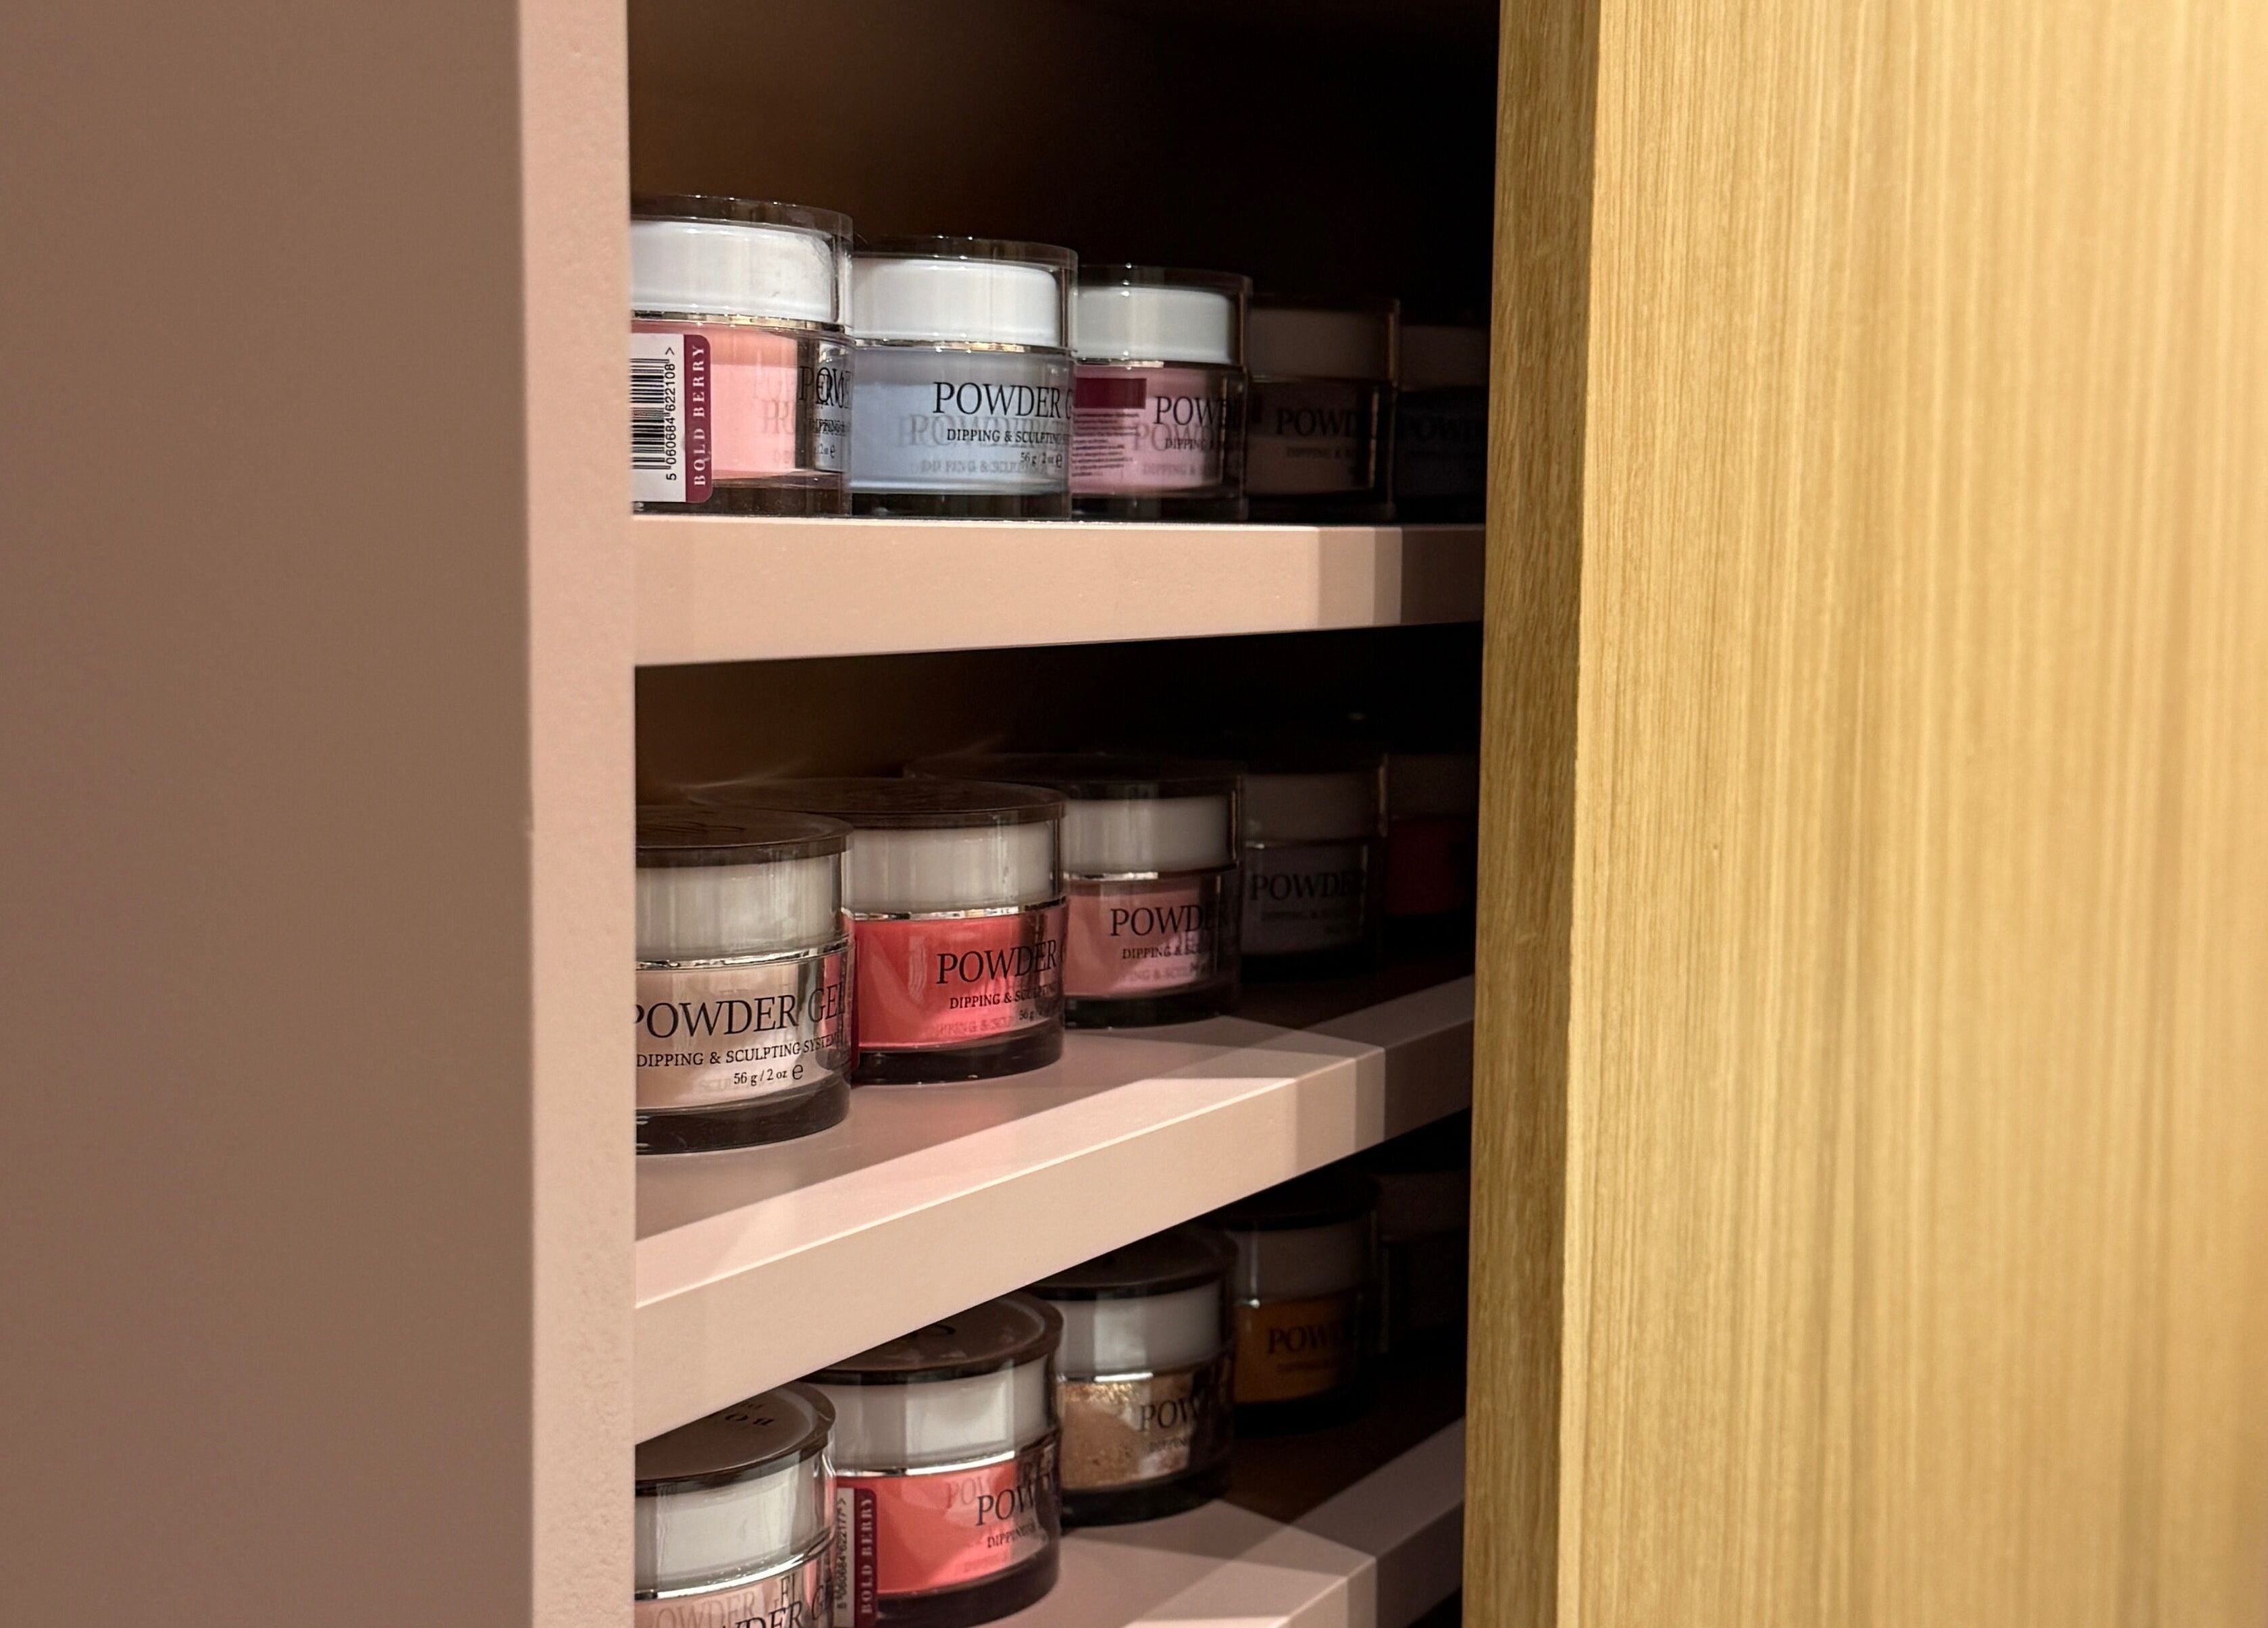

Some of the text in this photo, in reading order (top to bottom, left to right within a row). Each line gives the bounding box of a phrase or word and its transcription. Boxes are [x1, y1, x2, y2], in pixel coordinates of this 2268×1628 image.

[932, 381, 1062, 418] POWDER
[692, 346, 706, 486] BOLD BERRY
[947, 428, 1000, 442] DIPPING
[1004, 430, 1012, 442] &
[935, 939, 1057, 985] POWDER
[949, 993, 1001, 1010] DIPPING
[1004, 992, 1012, 1004] &
[636, 1052, 704, 1067] DIPPING
[709, 1051, 721, 1065] &
[725, 1042, 800, 1064] SCULPTING
[733, 1072, 748, 1085] 56
[750, 1074, 758, 1087] g
[767, 1069, 773, 1081] 2
[860, 1498, 873, 1614] BOLD BERRY
